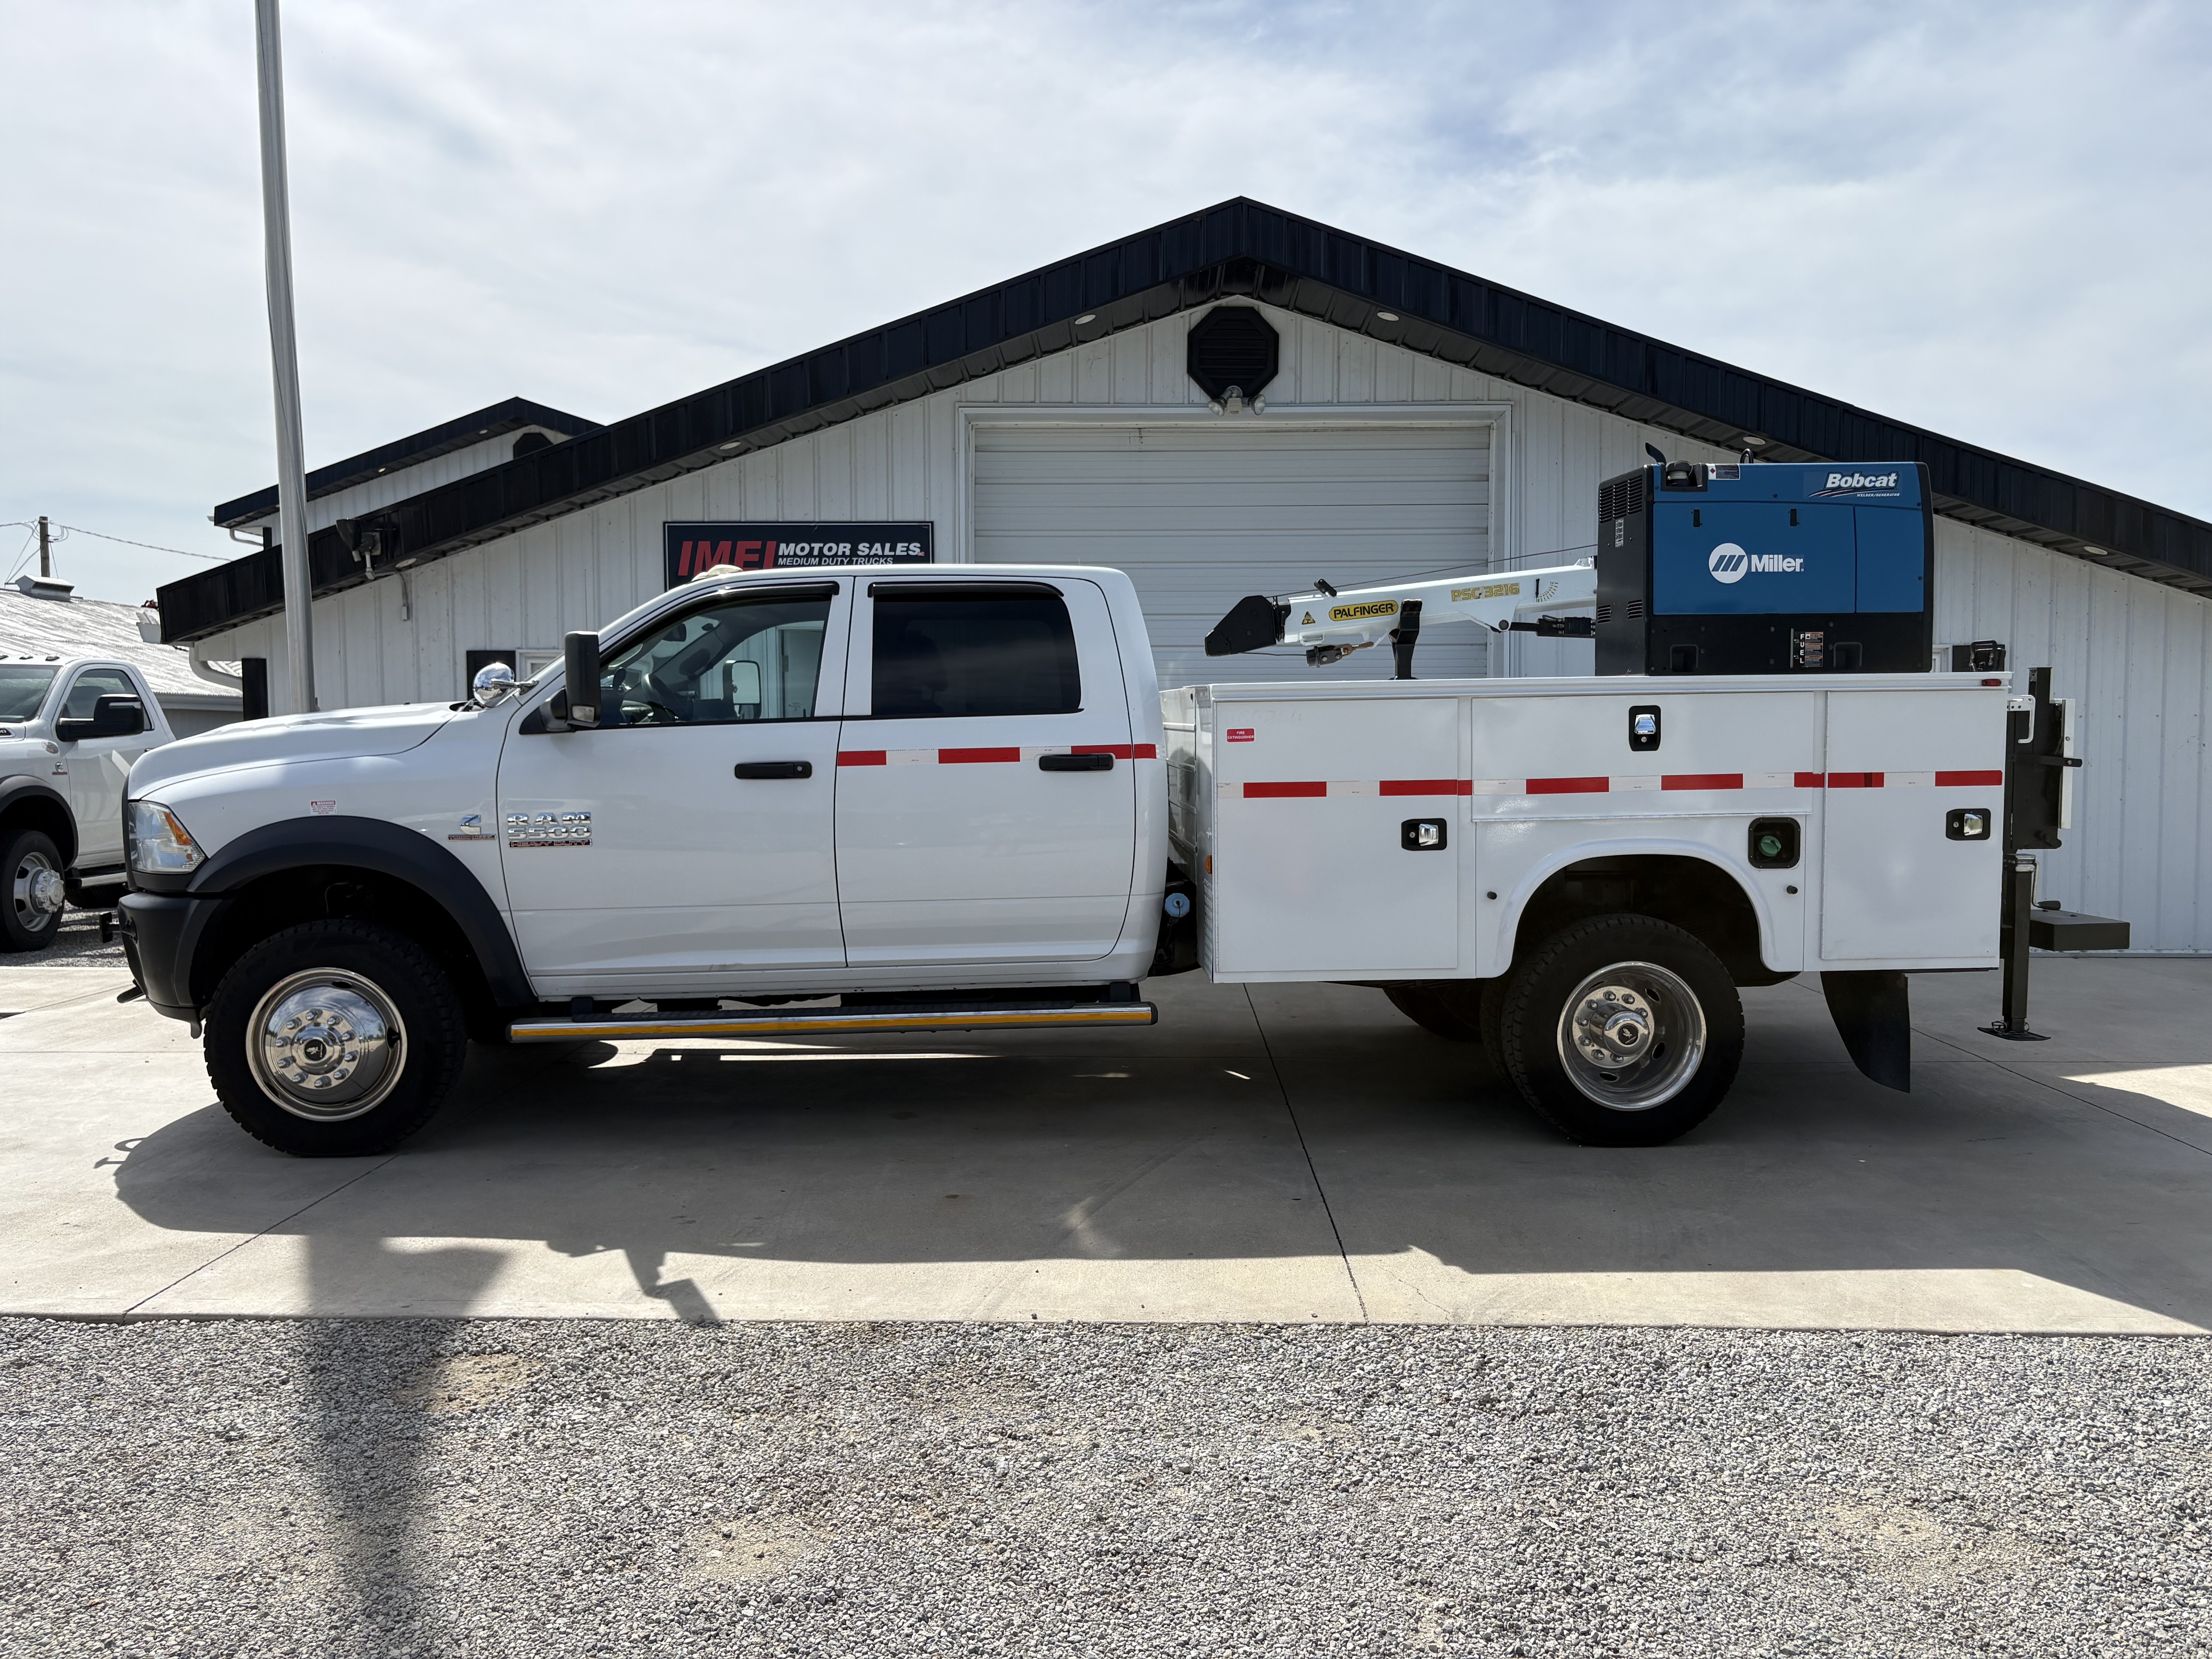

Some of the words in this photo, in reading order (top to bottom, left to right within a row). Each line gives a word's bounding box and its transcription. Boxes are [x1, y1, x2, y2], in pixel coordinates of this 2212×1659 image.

[1826, 473, 1897, 488] Bobcat
[678, 541, 777, 576] IMEI
[778, 543, 851, 556] MOTOR
[857, 543, 921, 556] SALES
[821, 557, 849, 565] DUTY
[1451, 587, 1482, 601] PSC
[1484, 582, 1519, 598] 3216
[1334, 603, 1394, 618] PALFINGER
[508, 812, 591, 826] RAM
[508, 826, 592, 839] 5500
